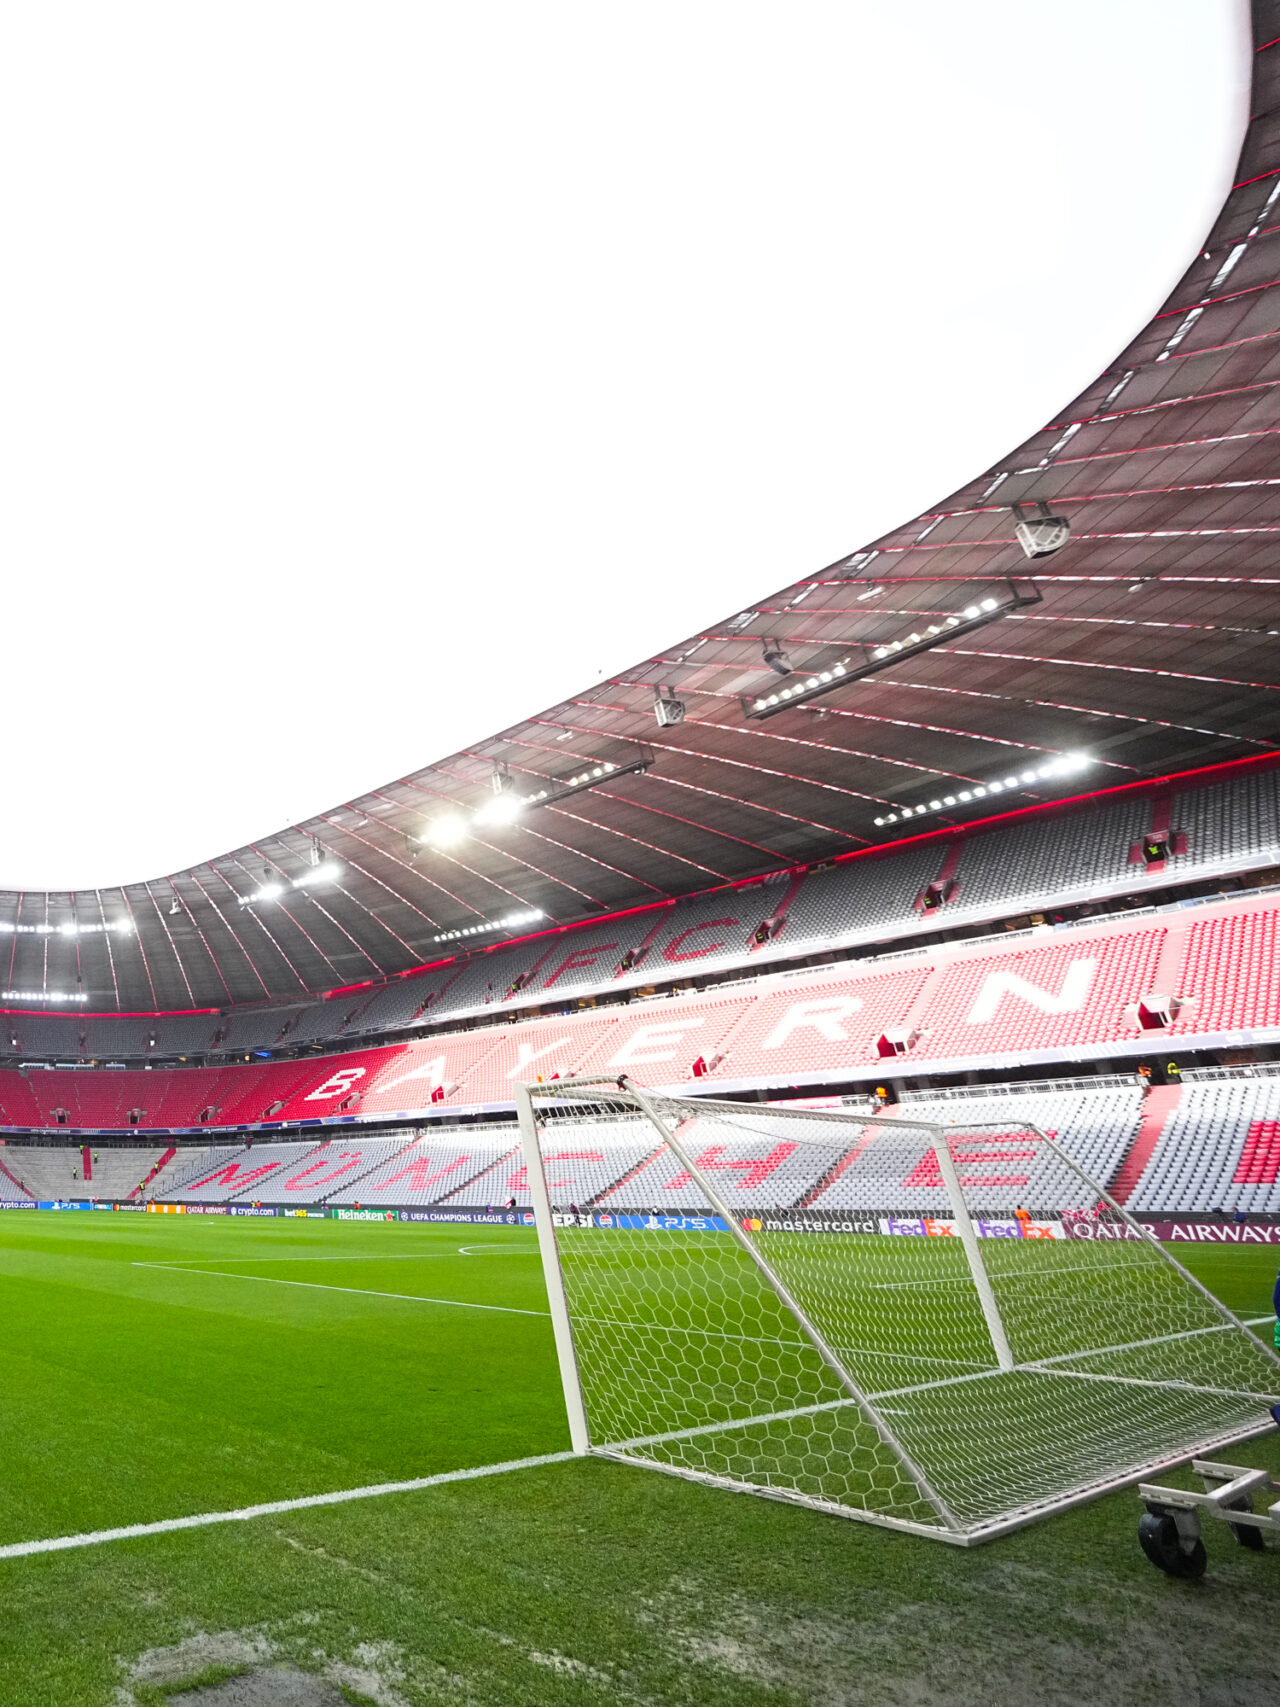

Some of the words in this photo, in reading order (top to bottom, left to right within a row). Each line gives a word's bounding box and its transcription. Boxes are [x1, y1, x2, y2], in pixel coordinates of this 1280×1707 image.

[305, 957, 1099, 1102] BAYERN
[187, 1206, 204, 1214] QATAR
[205, 1207, 227, 1215] AIRWAYS
[238, 1208, 274, 1217] crypto.com
[284, 1208, 308, 1218] bet365
[338, 1210, 385, 1221] Heineken
[411, 1213, 429, 1221] UEFA
[430, 1213, 471, 1222] CHAMPIONS
[473, 1214, 504, 1224] LEAGUE
[665, 1218, 707, 1229] PS5
[766, 1219, 875, 1233] mastercard
[887, 1219, 956, 1237] FedEx
[977, 1219, 1056, 1240] FedEx
[1073, 1223, 1160, 1241] QATAR
